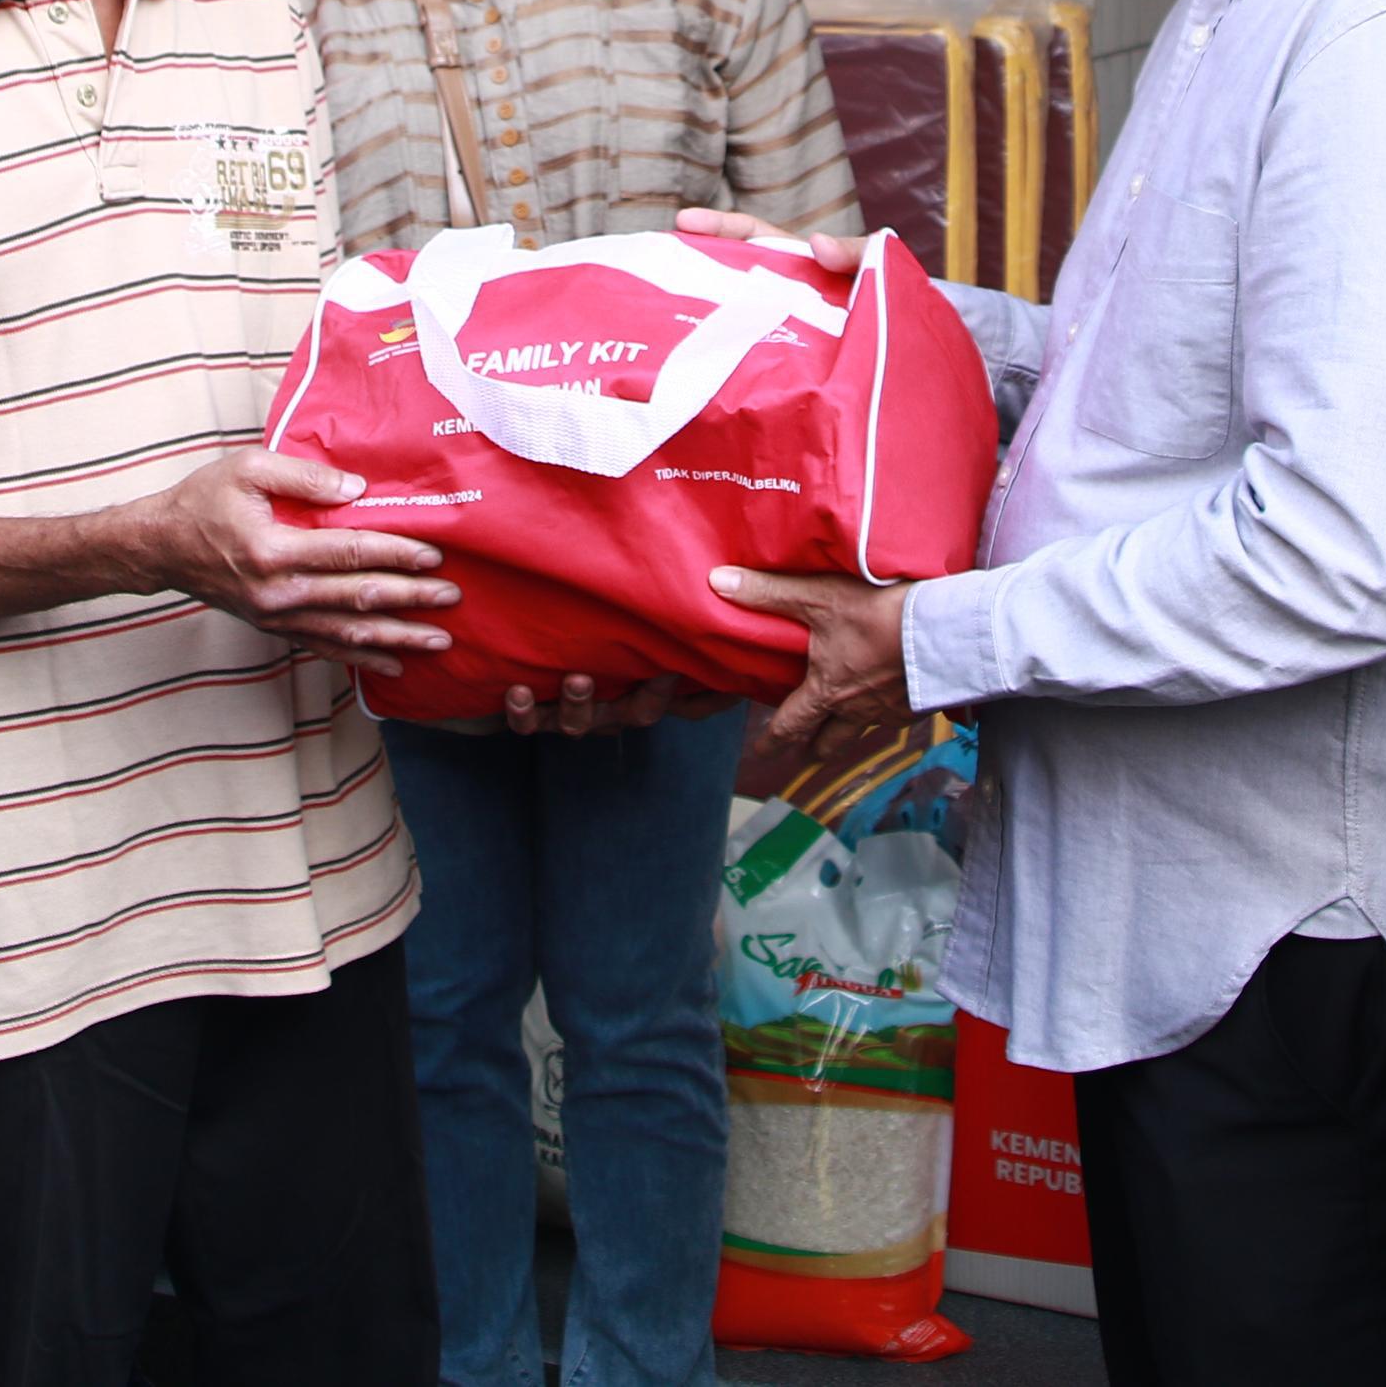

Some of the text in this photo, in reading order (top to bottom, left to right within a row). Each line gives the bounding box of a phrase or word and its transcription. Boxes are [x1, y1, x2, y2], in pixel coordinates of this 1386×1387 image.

[268, 151, 307, 191] 69
[466, 340, 649, 376] FAMILY KIT
[654, 467, 690, 481] TIDAK
[990, 1129, 1081, 1166] KEMEN
[995, 1158, 1083, 1195] REPUB
